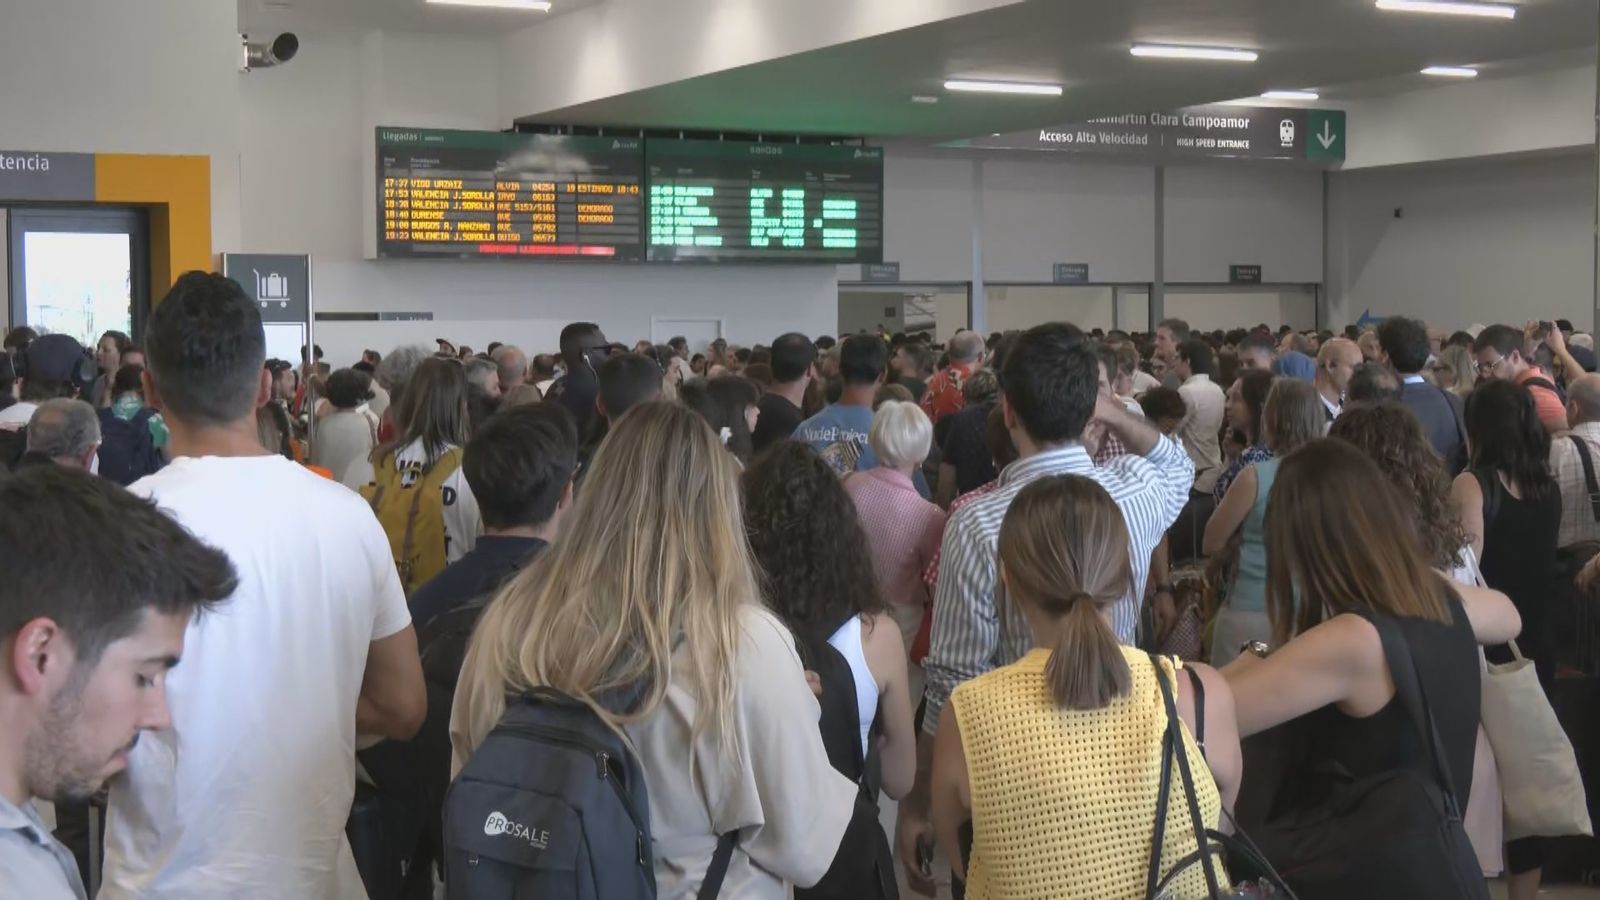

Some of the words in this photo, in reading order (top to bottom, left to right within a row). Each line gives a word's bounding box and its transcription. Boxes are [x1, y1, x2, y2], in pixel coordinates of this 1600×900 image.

[1150, 112, 1179, 126] Clara
[1182, 113, 1250, 129] Campoamor
[383, 131, 418, 143] Llegadas
[1039, 129, 1073, 143] Acceso
[1076, 132, 1096, 144] Alta
[1098, 132, 1148, 145] Velocidad
[1176, 137, 1194, 147] HIGH
[1195, 138, 1216, 149] SPEED
[1217, 139, 1250, 150] ENTRANCE
[0, 153, 49, 171] tencia
[385, 178, 408, 189] 17:37
[411, 179, 431, 189] VIGO
[411, 190, 449, 199] VALENCIA
[452, 191, 495, 200] J.SOROLLA
[411, 200, 449, 209] VALENCIA
[452, 201, 495, 210] J.SOROLLA
[411, 231, 450, 241] VALENCIA
[453, 233, 495, 241] J.SOROLLA
[487, 816, 549, 845] PROSALE
